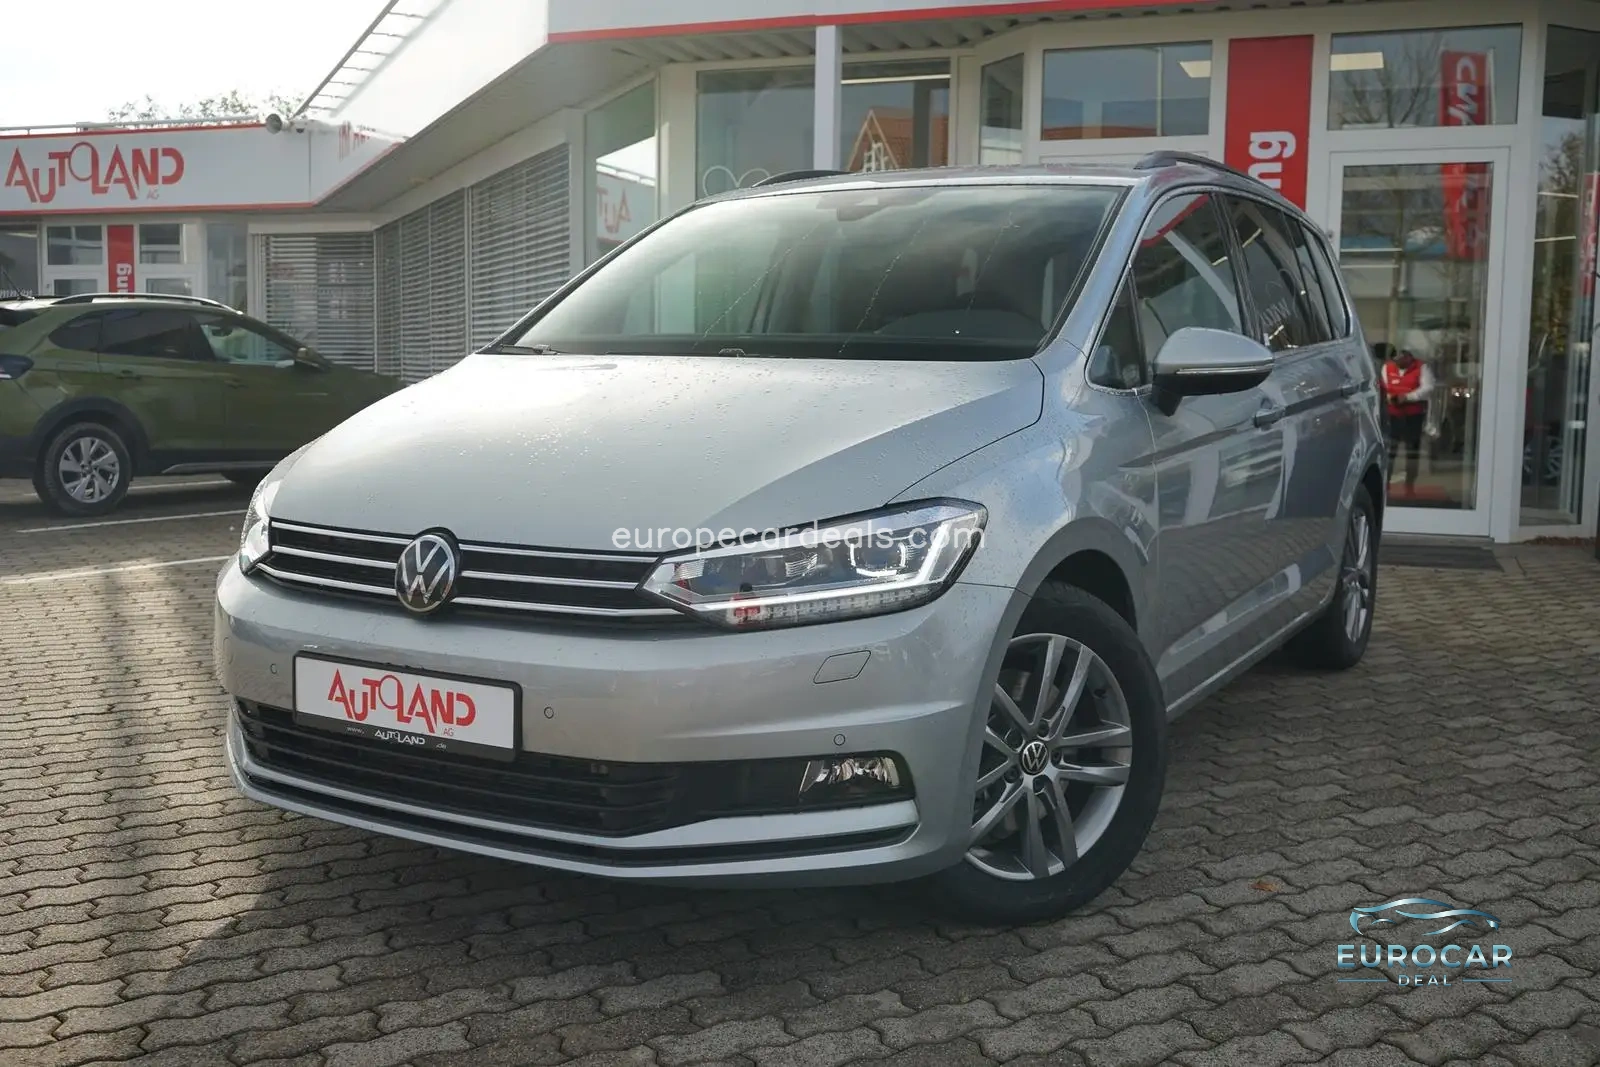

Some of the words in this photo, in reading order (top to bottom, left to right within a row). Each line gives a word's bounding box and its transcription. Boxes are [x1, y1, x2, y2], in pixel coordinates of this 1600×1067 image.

[5, 141, 185, 203] AUTOLAND
[328, 668, 477, 735] AUTOLAND
[374, 729, 426, 746] AUTOLAND
[442, 726, 455, 737] AG
